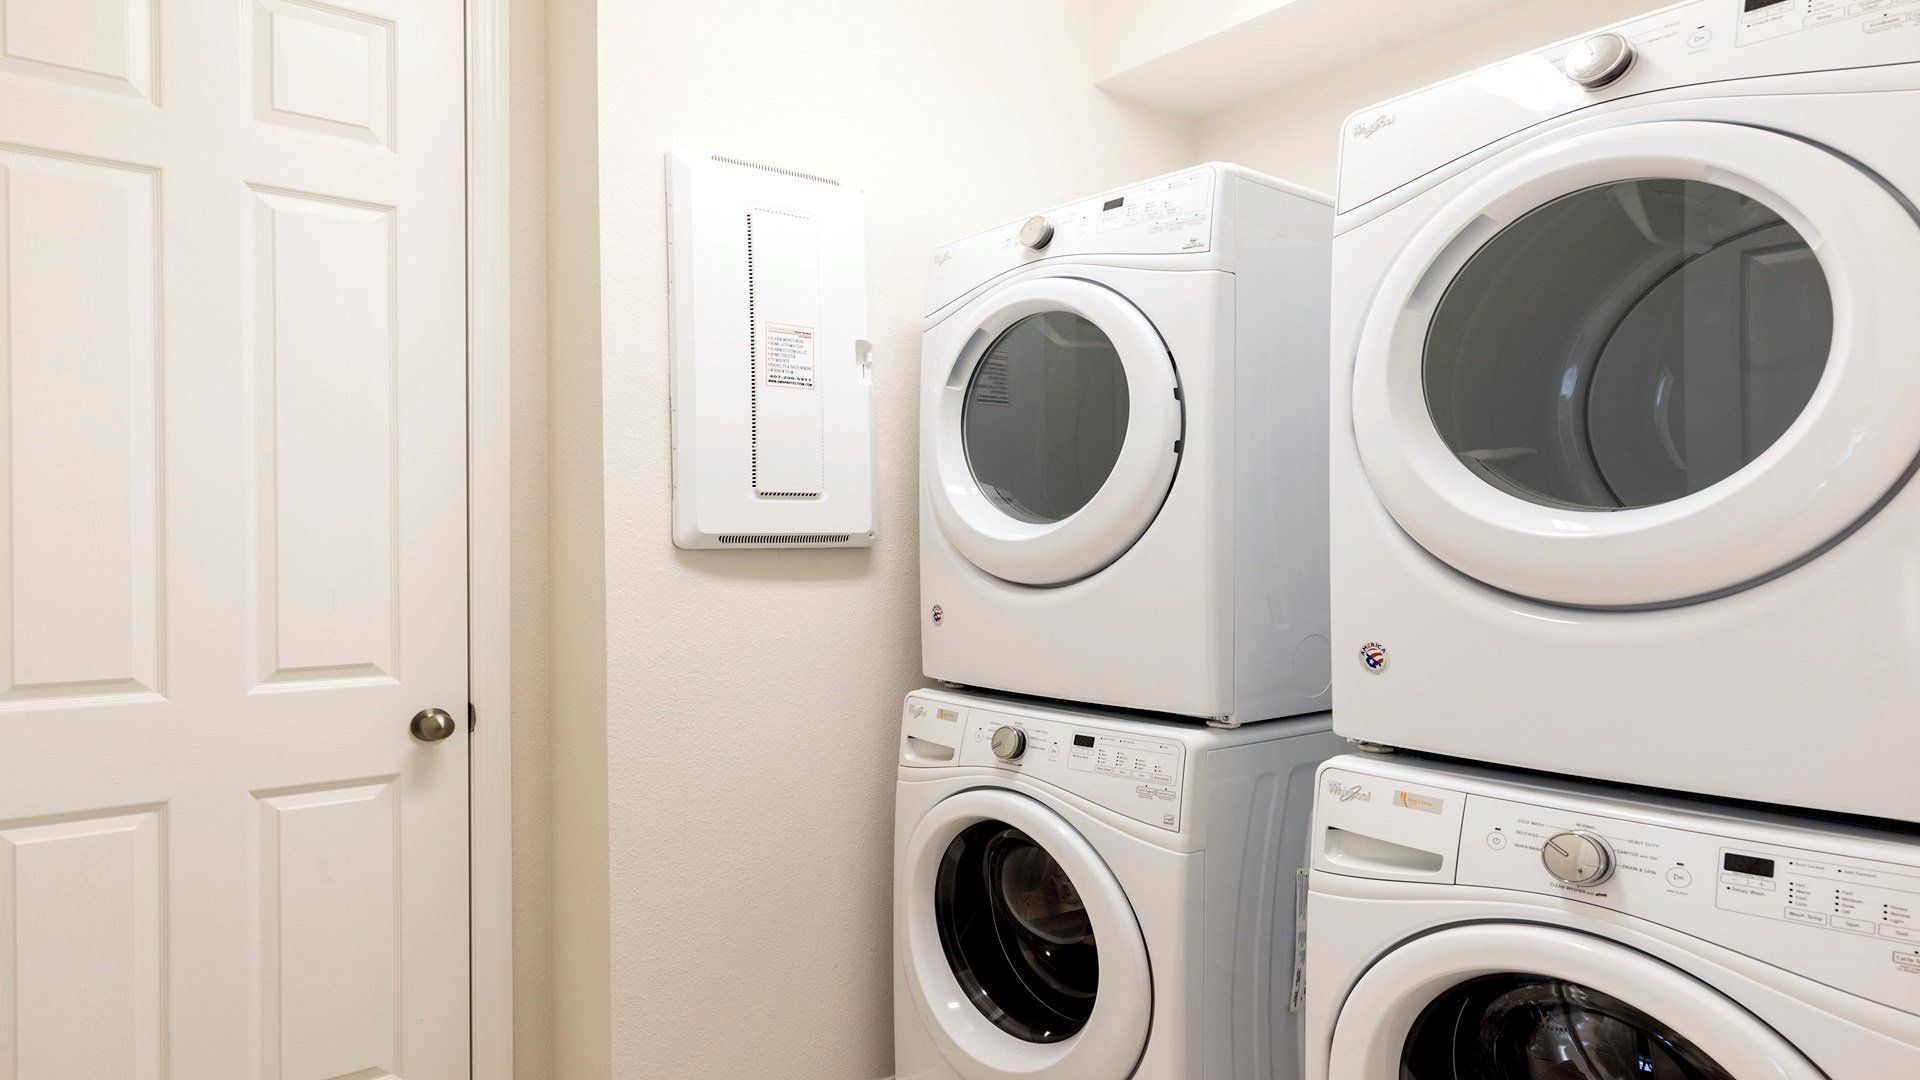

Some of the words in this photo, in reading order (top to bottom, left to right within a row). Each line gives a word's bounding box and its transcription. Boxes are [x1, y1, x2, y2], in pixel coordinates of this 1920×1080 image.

[1360, 642, 1386, 656] AMERICA
[1328, 780, 1371, 802] Whirlpool
[1622, 864, 1638, 872] DRAIN
[1807, 914, 1823, 922] Temp
